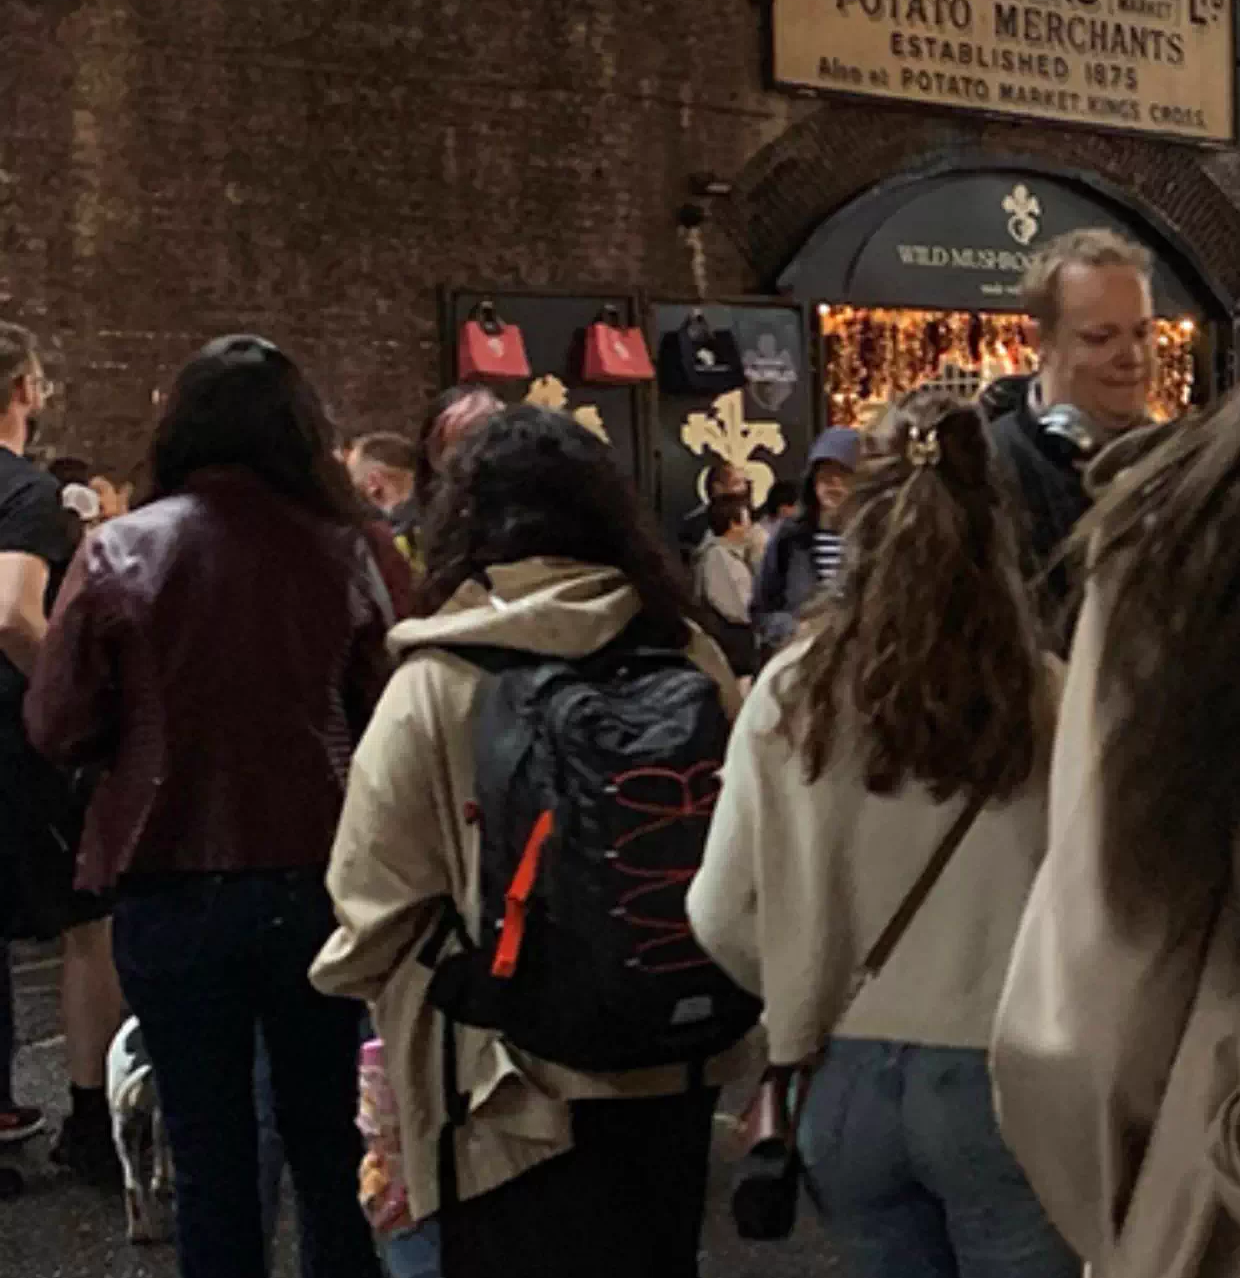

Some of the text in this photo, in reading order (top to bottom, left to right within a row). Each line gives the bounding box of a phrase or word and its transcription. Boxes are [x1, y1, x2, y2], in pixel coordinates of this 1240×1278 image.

[994, 1, 1185, 66] MERCHANTS
[890, 31, 1138, 92] ESTABLISHED 1875
[902, 67, 989, 102] POTATO
[897, 243, 950, 267] WILD
